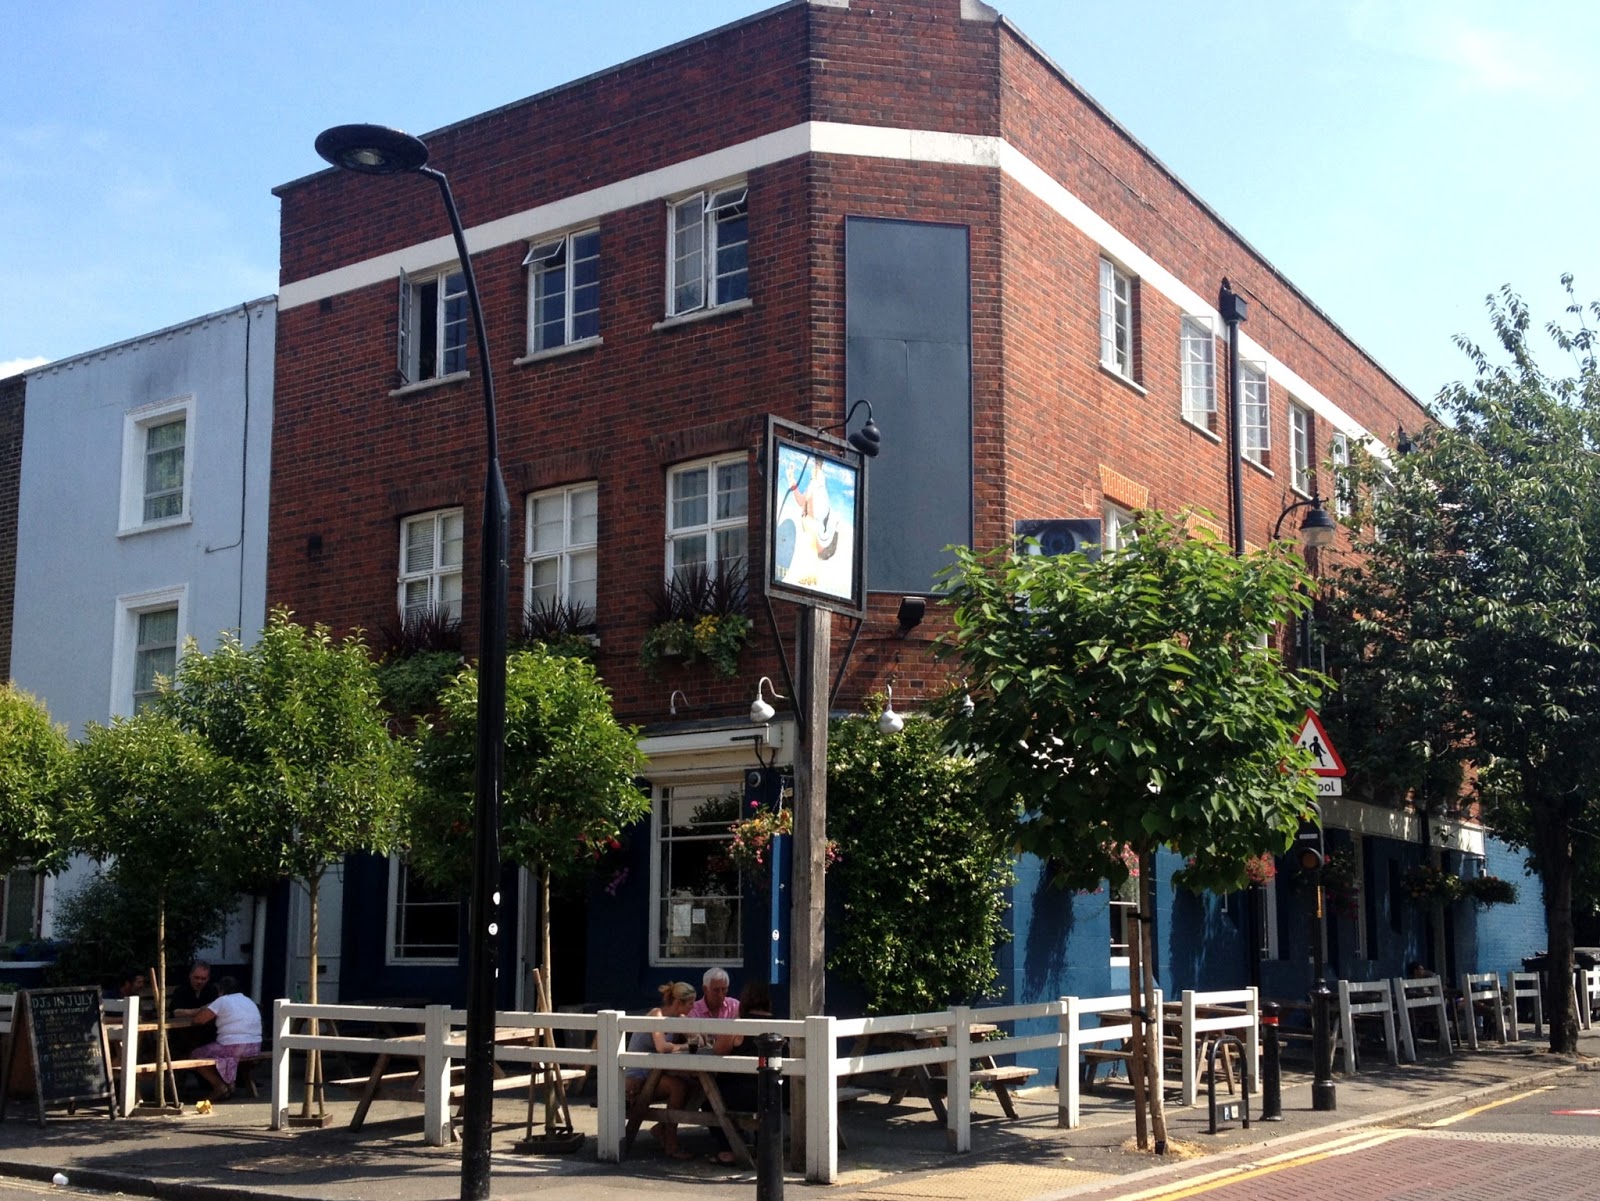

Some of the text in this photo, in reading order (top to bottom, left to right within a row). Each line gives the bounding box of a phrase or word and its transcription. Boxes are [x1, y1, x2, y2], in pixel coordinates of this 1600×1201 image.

[53, 995, 65, 1007] IN
[67, 993, 93, 1006] JULY
[60, 1006, 89, 1014] SATURDAY
